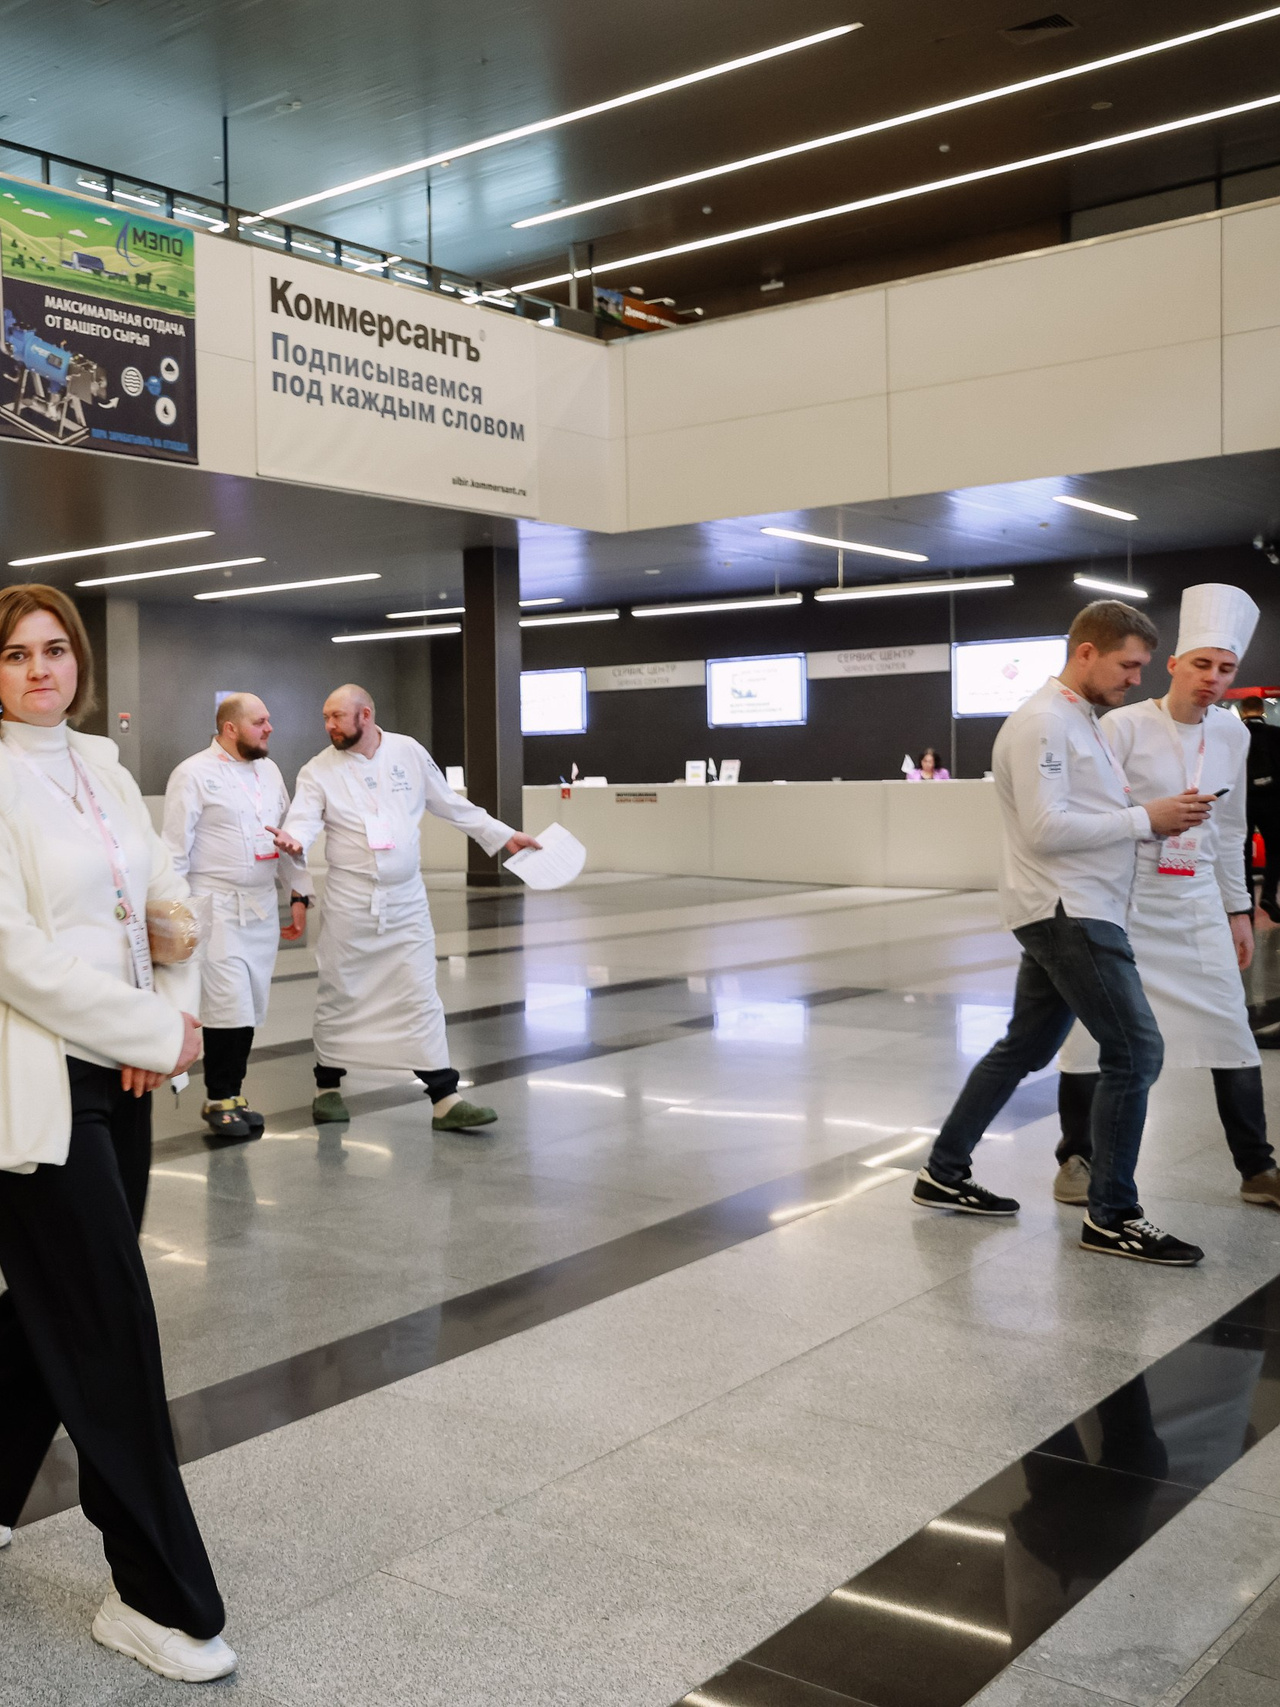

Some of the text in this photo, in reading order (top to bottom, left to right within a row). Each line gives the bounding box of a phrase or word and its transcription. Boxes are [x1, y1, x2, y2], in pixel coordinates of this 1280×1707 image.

[133, 227, 184, 257] МЗПО
[44, 295, 186, 337] МАКСИМАЛЬНАЯ ОТДАЧА
[44, 313, 151, 348] ОТ ВАШЕГО СЫРЬЯ
[270, 276, 480, 363] Коммерсантъ
[271, 331, 483, 405] Подписываемся
[272, 371, 525, 442] под каждым словом
